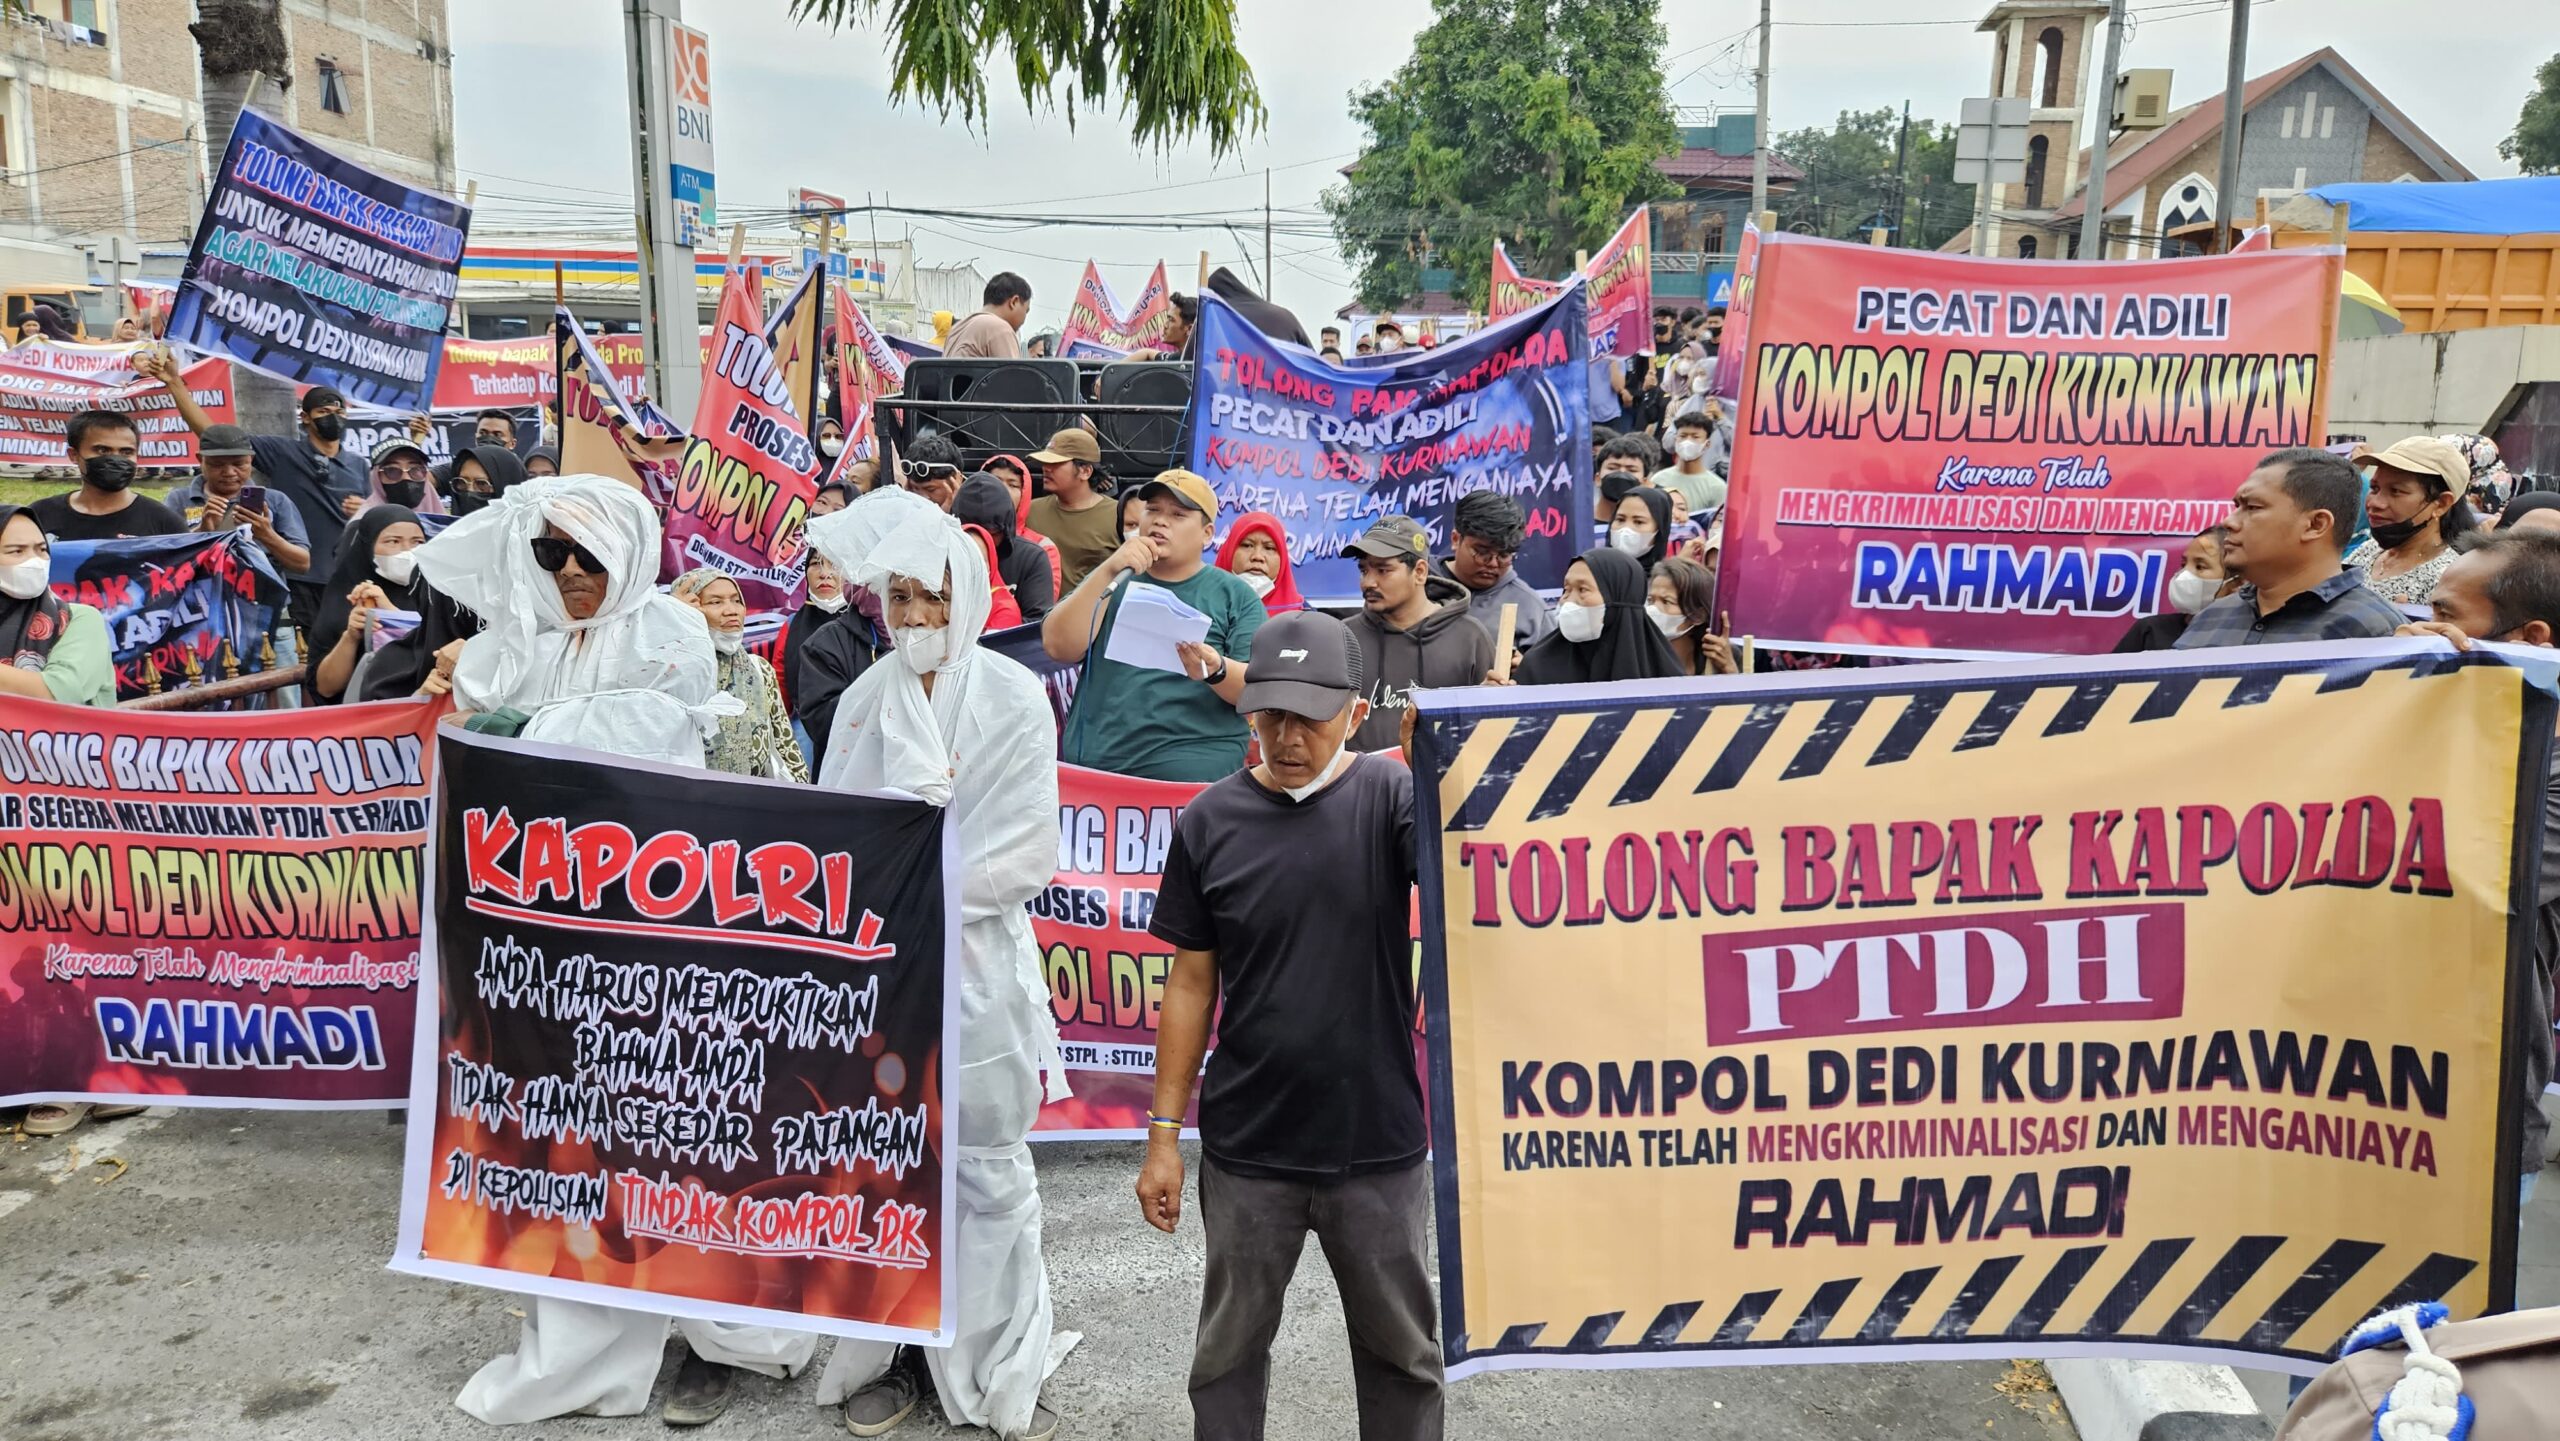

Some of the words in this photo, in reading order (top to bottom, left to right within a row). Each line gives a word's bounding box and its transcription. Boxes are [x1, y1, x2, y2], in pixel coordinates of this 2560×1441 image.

[677, 105, 711, 144] BNI
[214, 186, 291, 239] UNTUK
[234, 140, 314, 203] TOLONG
[309, 173, 371, 231] BAPAK
[681, 172, 700, 190] ATM
[203, 225, 266, 273] AGAR
[267, 246, 377, 315] MELAKUKAN
[207, 285, 306, 350] KOMPOL
[1855, 287, 1998, 337] PECAT
[2007, 293, 2103, 338] DAN
[2112, 293, 2229, 340] ADILI
[0, 374, 45, 391] ONG
[48, 381, 93, 397] PAK
[448, 344, 498, 367] Tolong
[501, 343, 549, 366] bapak
[469, 372, 536, 397] Terhadap
[1216, 347, 1336, 411] TOLONG
[1351, 386, 1419, 417] PAK
[25, 417, 68, 434] TELAH
[162, 417, 190, 433] DAN
[37, 396, 94, 414] KOMPOL
[98, 397, 136, 412] DEDI
[1210, 392, 1320, 441] PECAT
[1319, 418, 1394, 448] DAN
[1395, 396, 1481, 443] ADILI
[1751, 343, 1929, 439] KOMPOL
[1937, 348, 2046, 444] DEDI
[2044, 352, 2319, 448] KURNIAWAN
[727, 402, 818, 475] PROSES
[1206, 436, 1304, 479] KOMPOL
[1206, 479, 1309, 522] KARENA
[1316, 484, 1398, 522] TELAH
[1936, 456, 2037, 493] Karena
[2038, 455, 2110, 490] Telah
[1777, 488, 2039, 533] MENGKRIMINALISASI
[2039, 496, 2096, 533] DAN
[1851, 540, 2168, 617] RAHMADI
[0, 729, 109, 789] OLONG
[109, 735, 240, 794] BAPAK
[239, 733, 425, 795] KAPOLDA
[28, 796, 116, 831] SEGERA
[117, 804, 259, 837] MELAKUKAN
[261, 807, 330, 839] PTDH
[129, 847, 231, 940] DEDI
[228, 846, 428, 941] KURNIAW
[1460, 824, 1760, 928] TOLONG
[1780, 815, 2046, 912] BAPAK
[2066, 796, 2456, 899] KAPOLDA
[44, 943, 136, 981] Karena
[134, 944, 206, 980] Telah
[208, 950, 419, 992] Mengkriminalisasi
[477, 936, 549, 1016] ANDA
[552, 954, 657, 1025] HARUS
[666, 963, 878, 1053] MEMBUKTIKAN
[1733, 913, 2154, 1037] PTDH
[96, 996, 386, 1071] RAHMADI
[1064, 1046, 1099, 1065] STPL
[573, 1023, 682, 1097] BAHWA
[684, 1035, 765, 1112] ANDA
[1501, 1052, 1787, 1121] KOMPOL
[1806, 1042, 1958, 1110] DEDI
[1980, 1028, 2452, 1121] KURNIAWAN
[449, 1051, 526, 1131] TIDAK
[520, 1072, 611, 1151] HANYA
[615, 1098, 758, 1173] SEKEDAR
[1502, 1128, 1632, 1172] KARENA
[1637, 1125, 1738, 1167] TELAH
[1747, 1114, 2090, 1165] MENGKRIMINALISASI
[2095, 1107, 2169, 1150] DAN
[2178, 1105, 2438, 1178] MENGANIAYA
[441, 1147, 472, 1192] DI
[475, 1161, 608, 1230] KEPOLISIAN
[616, 1168, 732, 1252] TINDAK
[733, 1190, 871, 1258] KOMPOL
[871, 1202, 931, 1260] DK
[1734, 1166, 2131, 1251] RAHMADI
